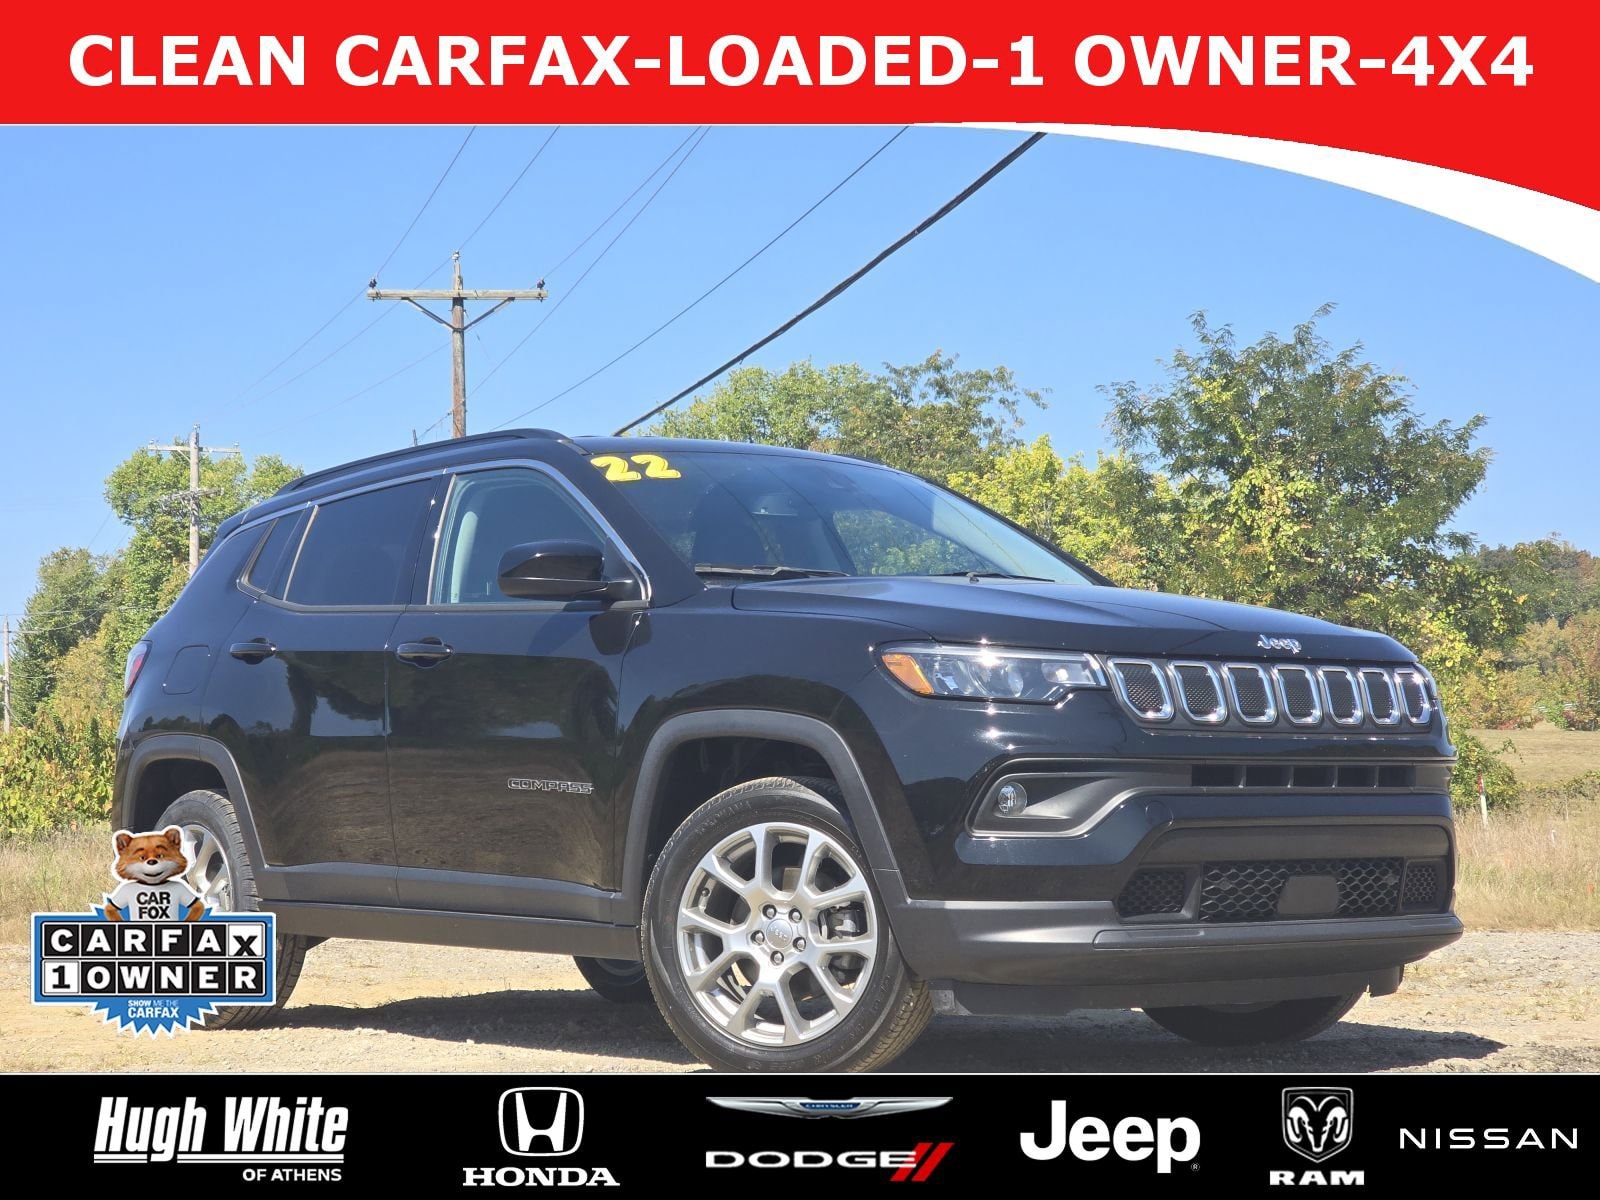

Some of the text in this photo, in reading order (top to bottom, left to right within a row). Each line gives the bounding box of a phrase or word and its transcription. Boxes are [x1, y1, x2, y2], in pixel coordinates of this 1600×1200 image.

[590, 455, 681, 482] 22
[1258, 634, 1302, 654] Jeep
[507, 778, 593, 794] COMPASS
